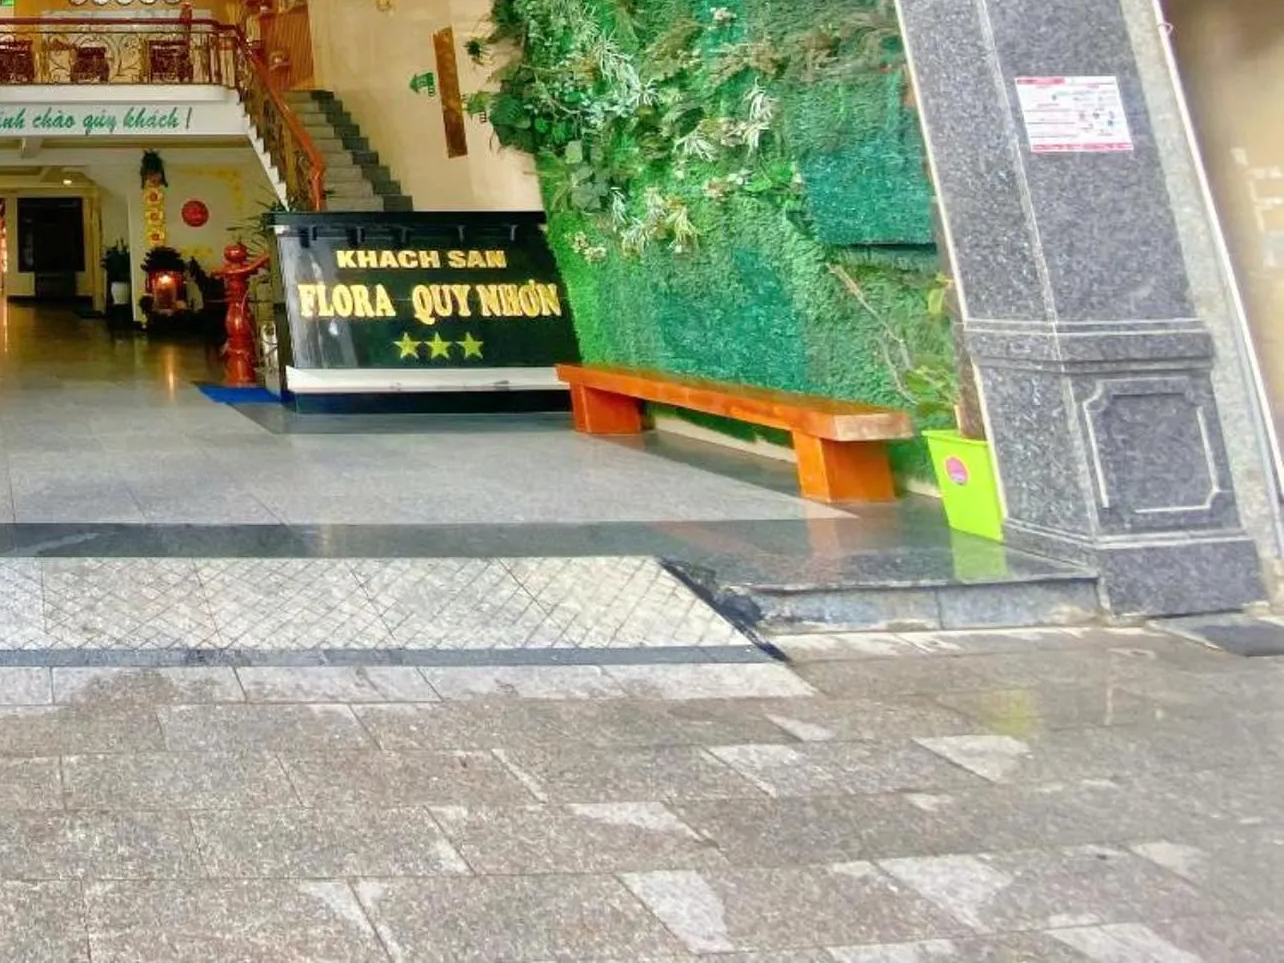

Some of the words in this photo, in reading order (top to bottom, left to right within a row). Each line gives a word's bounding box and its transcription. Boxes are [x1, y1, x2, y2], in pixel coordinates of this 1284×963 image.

[297, 283, 397, 318] FLORA
[411, 283, 472, 326] QUY
[475, 278, 562, 318] NHƠN
